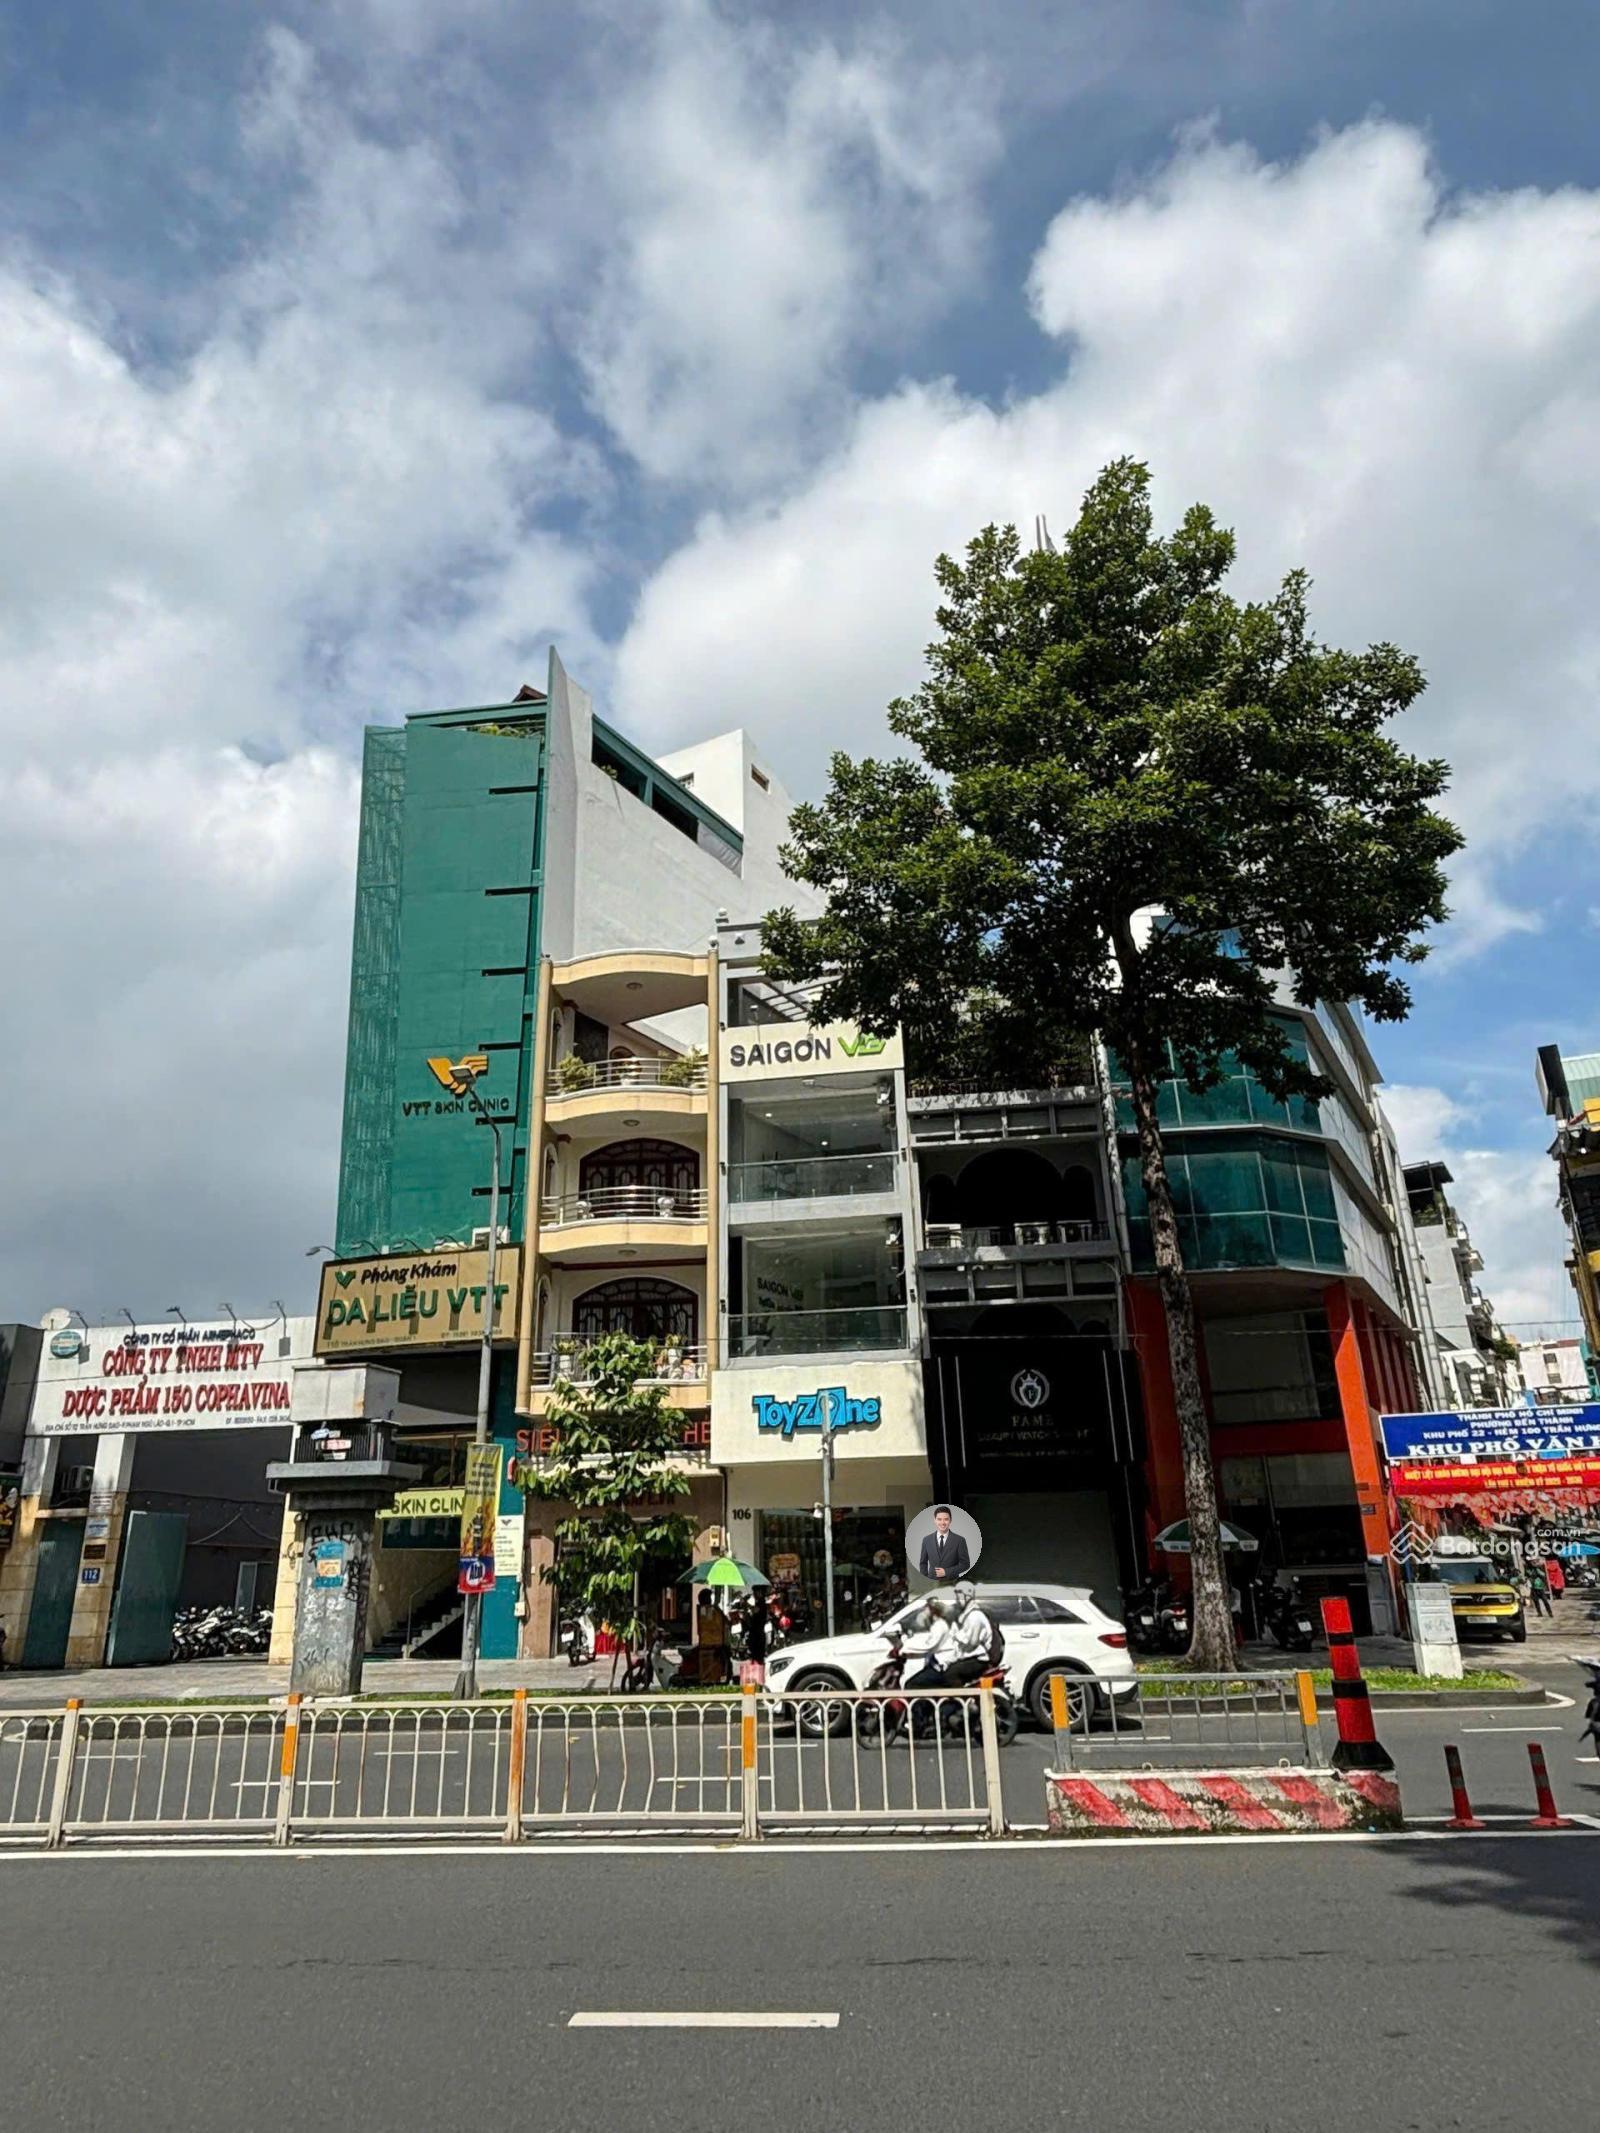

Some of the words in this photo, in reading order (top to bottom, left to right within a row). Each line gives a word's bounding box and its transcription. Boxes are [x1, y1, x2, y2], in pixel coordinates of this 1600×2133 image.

[730, 1037, 831, 1067] SAIGON
[402, 1101, 431, 1117] VTT
[434, 1101, 464, 1115] SKIN
[468, 1097, 509, 1113] CLINIC
[360, 1265, 411, 1286] Phòng
[410, 1260, 457, 1280] Khám
[328, 1297, 367, 1327] DA
[373, 1284, 439, 1321] LIỄU
[447, 1284, 509, 1315] VTT
[151, 1332, 161, 1345] TY
[102, 1344, 145, 1377] CÔNG
[149, 1348, 173, 1374] TY
[176, 1345, 224, 1374] TNHH
[225, 1343, 264, 1371] MTV
[62, 1385, 107, 1423] DƯỢC
[109, 1374, 161, 1416] PHẨM
[163, 1384, 193, 1414] 150
[195, 1381, 290, 1414] COPHAVINA
[1423, 1431, 1445, 1440] KHU
[1471, 1429, 1486, 1438] 22
[1521, 1426, 1541, 1435] 100
[1408, 1442, 1463, 1456] KHU
[1468, 1435, 1520, 1454] PHỐ
[1525, 1435, 1584, 1451] VĂN
[391, 1499, 426, 1514] SKIN
[732, 1508, 752, 1520] 106
[84, 1570, 98, 1580] 112
